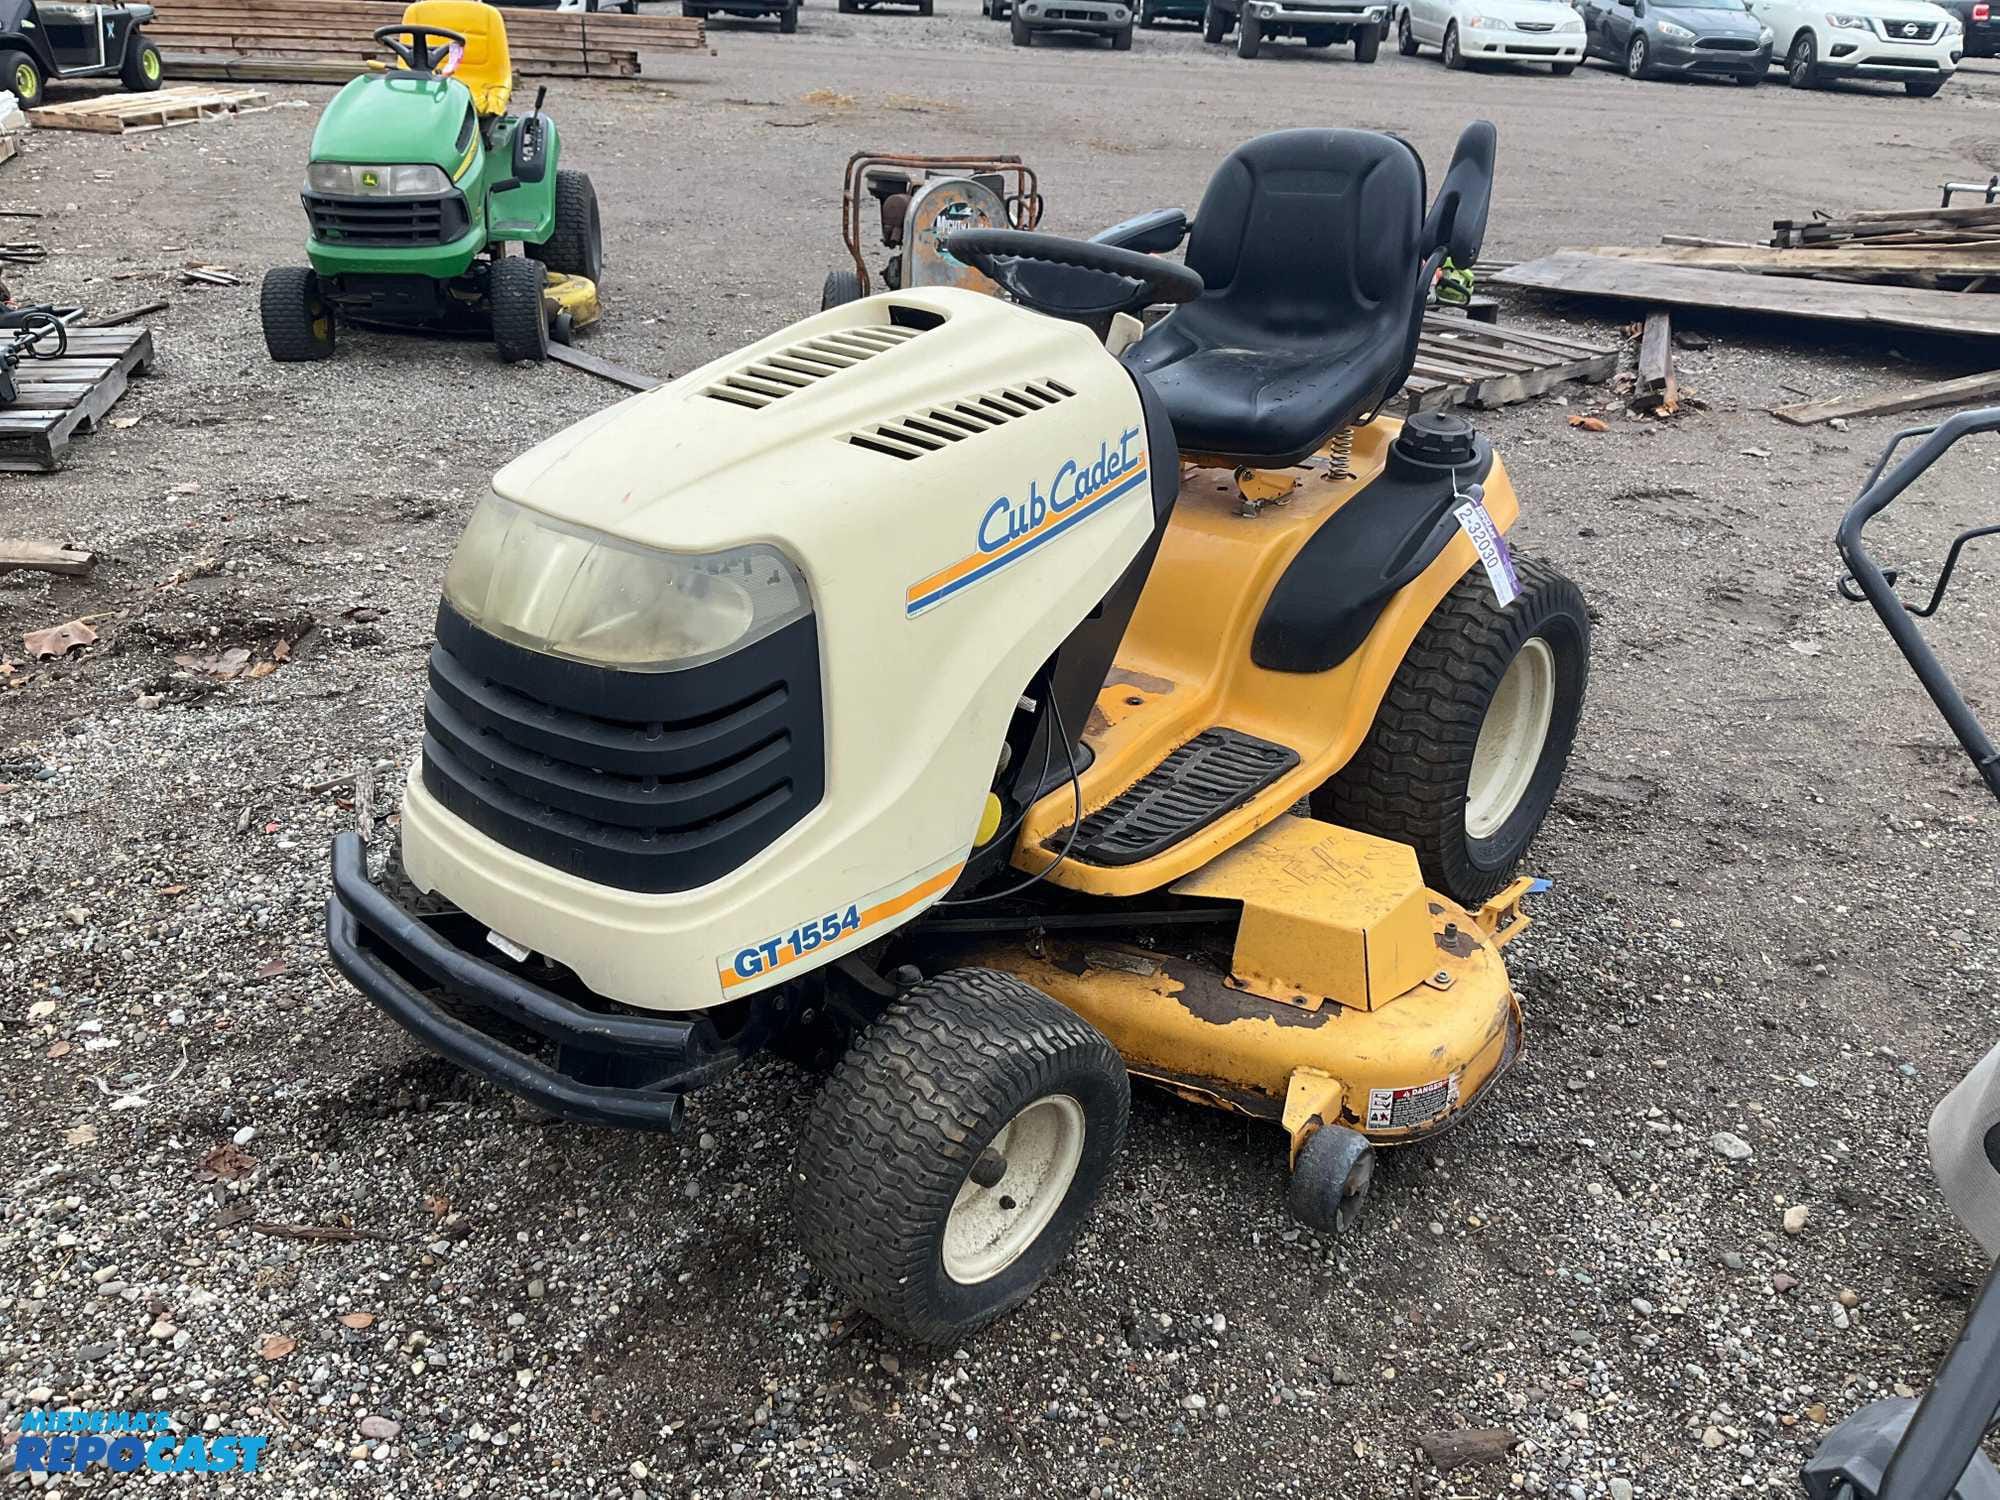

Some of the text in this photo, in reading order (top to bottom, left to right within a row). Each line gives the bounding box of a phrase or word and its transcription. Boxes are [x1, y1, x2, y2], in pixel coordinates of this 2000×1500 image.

[978, 425, 1139, 553] Cub Cadet
[1457, 508, 1500, 569] 2-32030
[734, 904, 861, 977] GT 1554
[1411, 1081, 1443, 1096] DANGER
